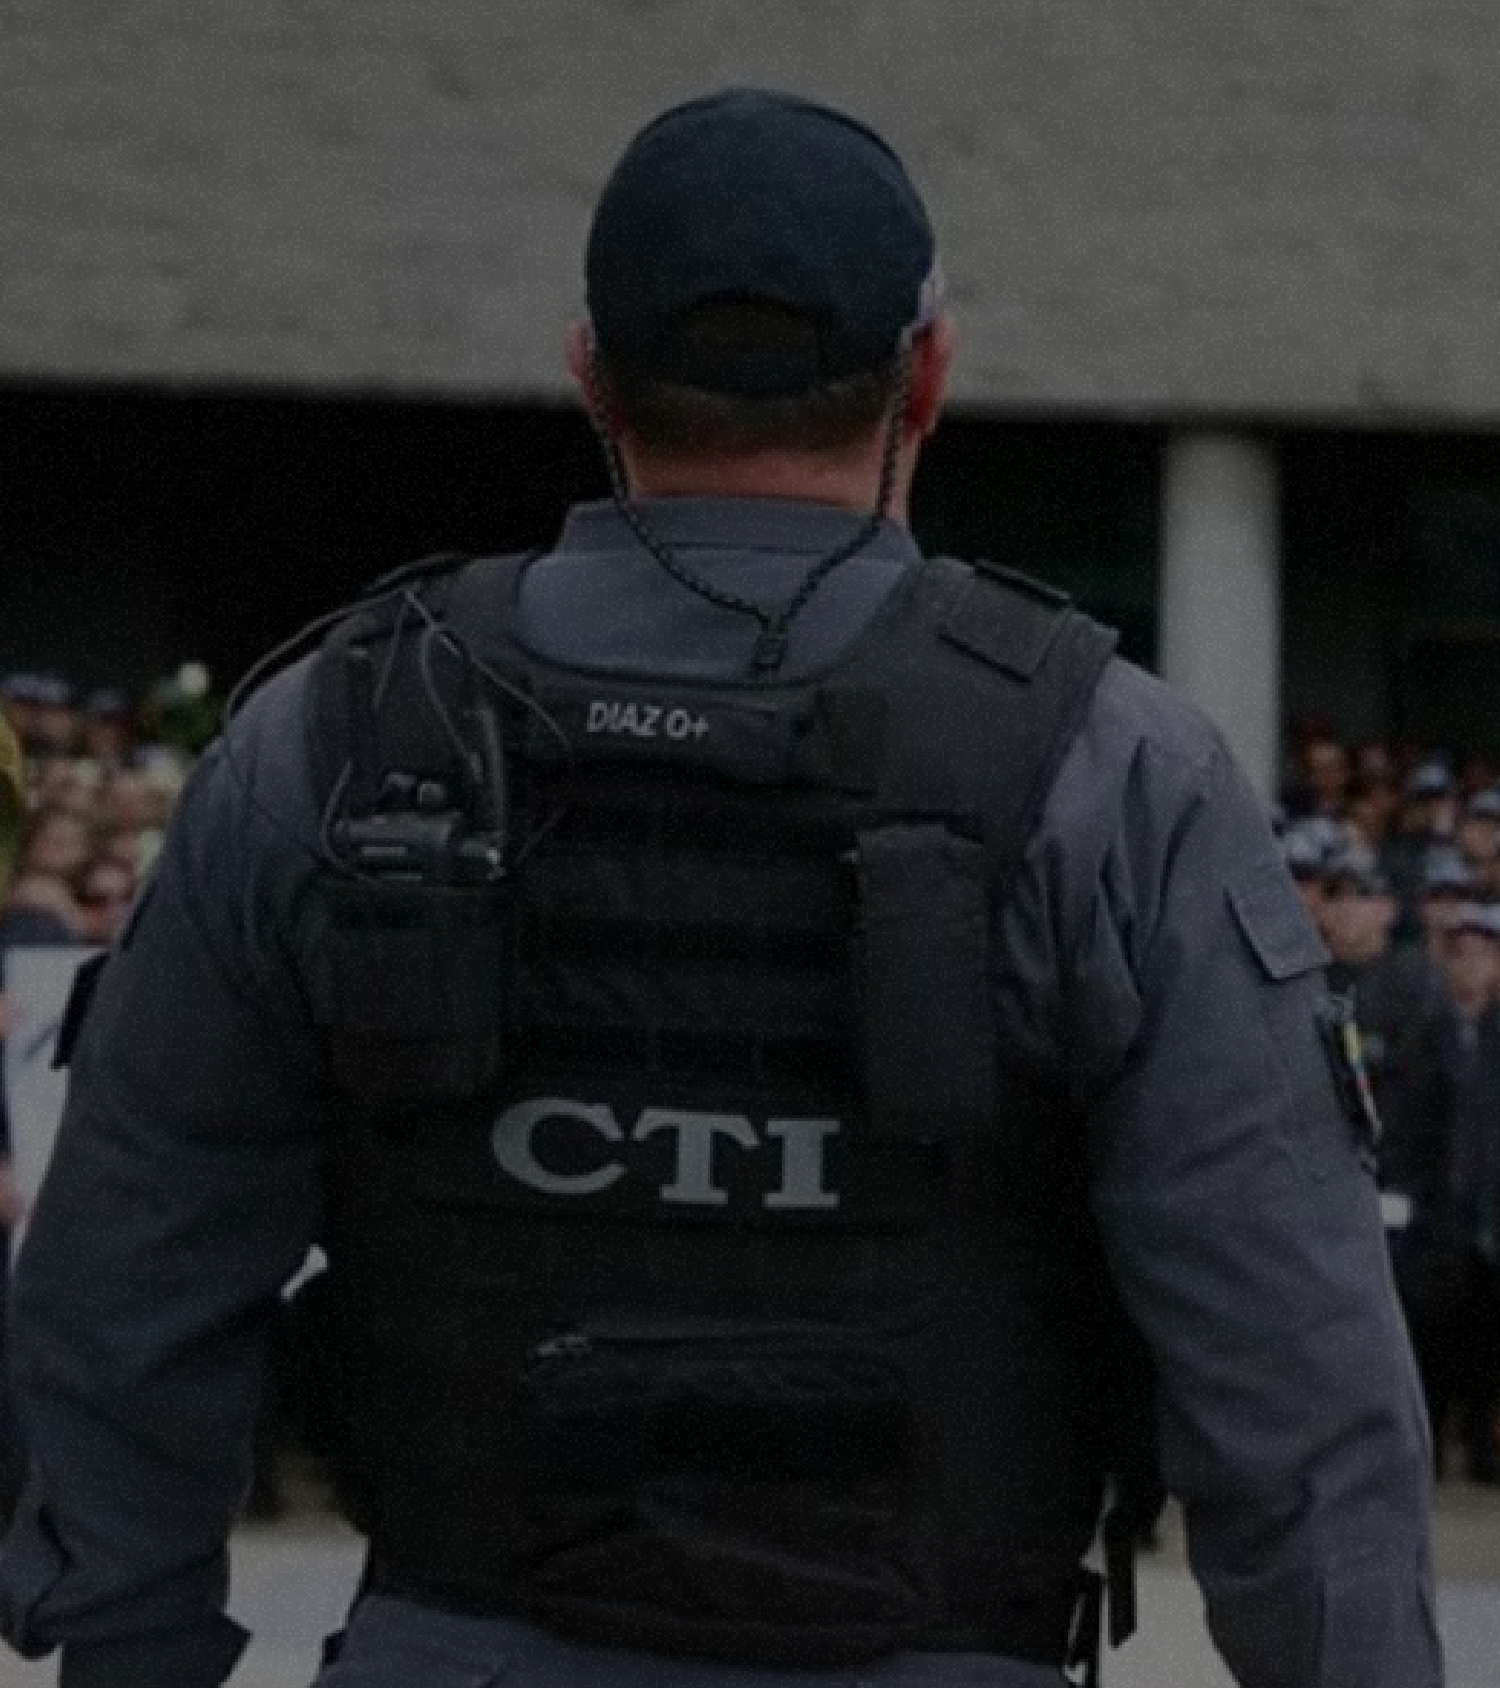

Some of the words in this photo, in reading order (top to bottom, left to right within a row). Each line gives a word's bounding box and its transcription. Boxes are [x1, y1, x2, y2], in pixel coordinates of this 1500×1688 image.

[586, 701, 663, 737] DIAZ
[665, 708, 710, 740] O+
[491, 1097, 841, 1210] CTI
